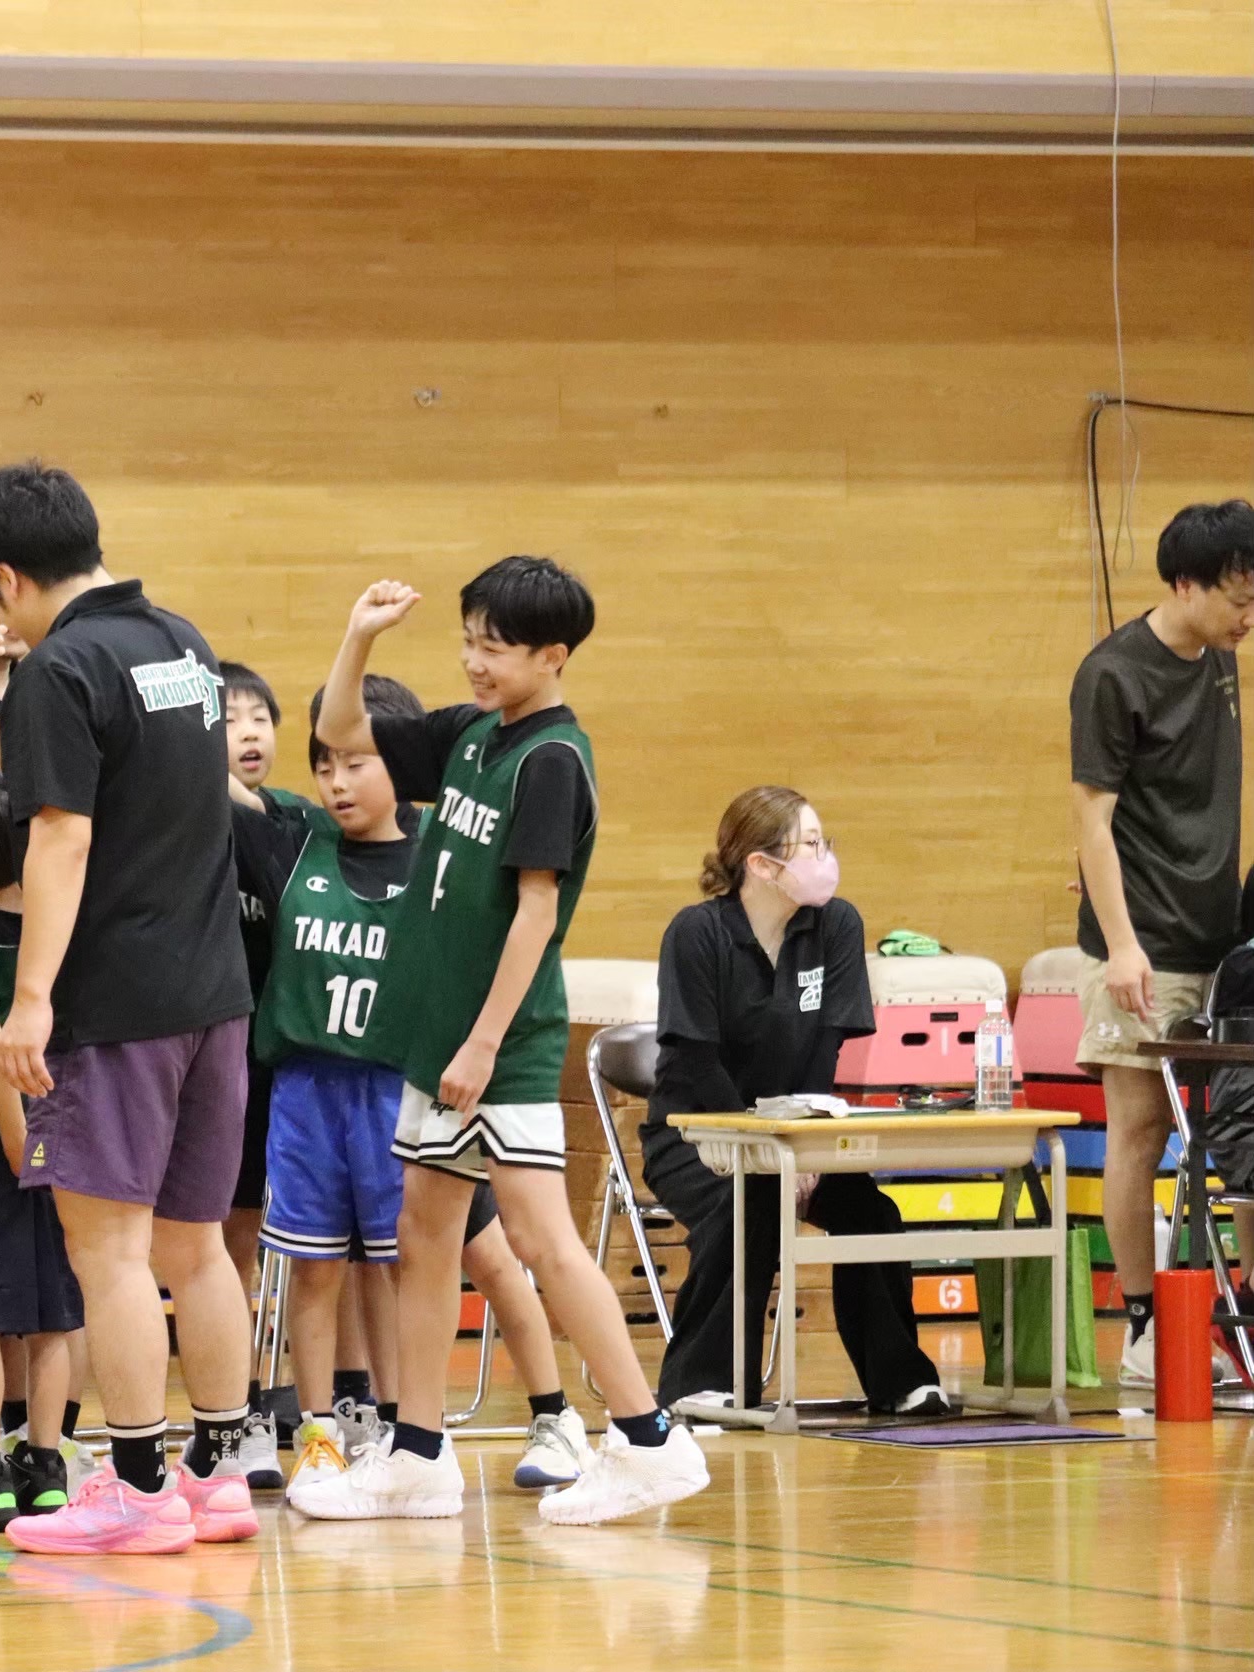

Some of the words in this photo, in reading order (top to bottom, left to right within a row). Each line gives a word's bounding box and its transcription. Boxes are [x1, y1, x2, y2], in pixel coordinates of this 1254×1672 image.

[140, 675, 206, 710] TAKADATE
[295, 916, 391, 960] TAKAD
[325, 975, 378, 1038] 10
[938, 1191, 954, 1214] 4
[939, 1279, 962, 1310] 6
[155, 1437, 166, 1453] E
[208, 1428, 242, 1441] EGO
